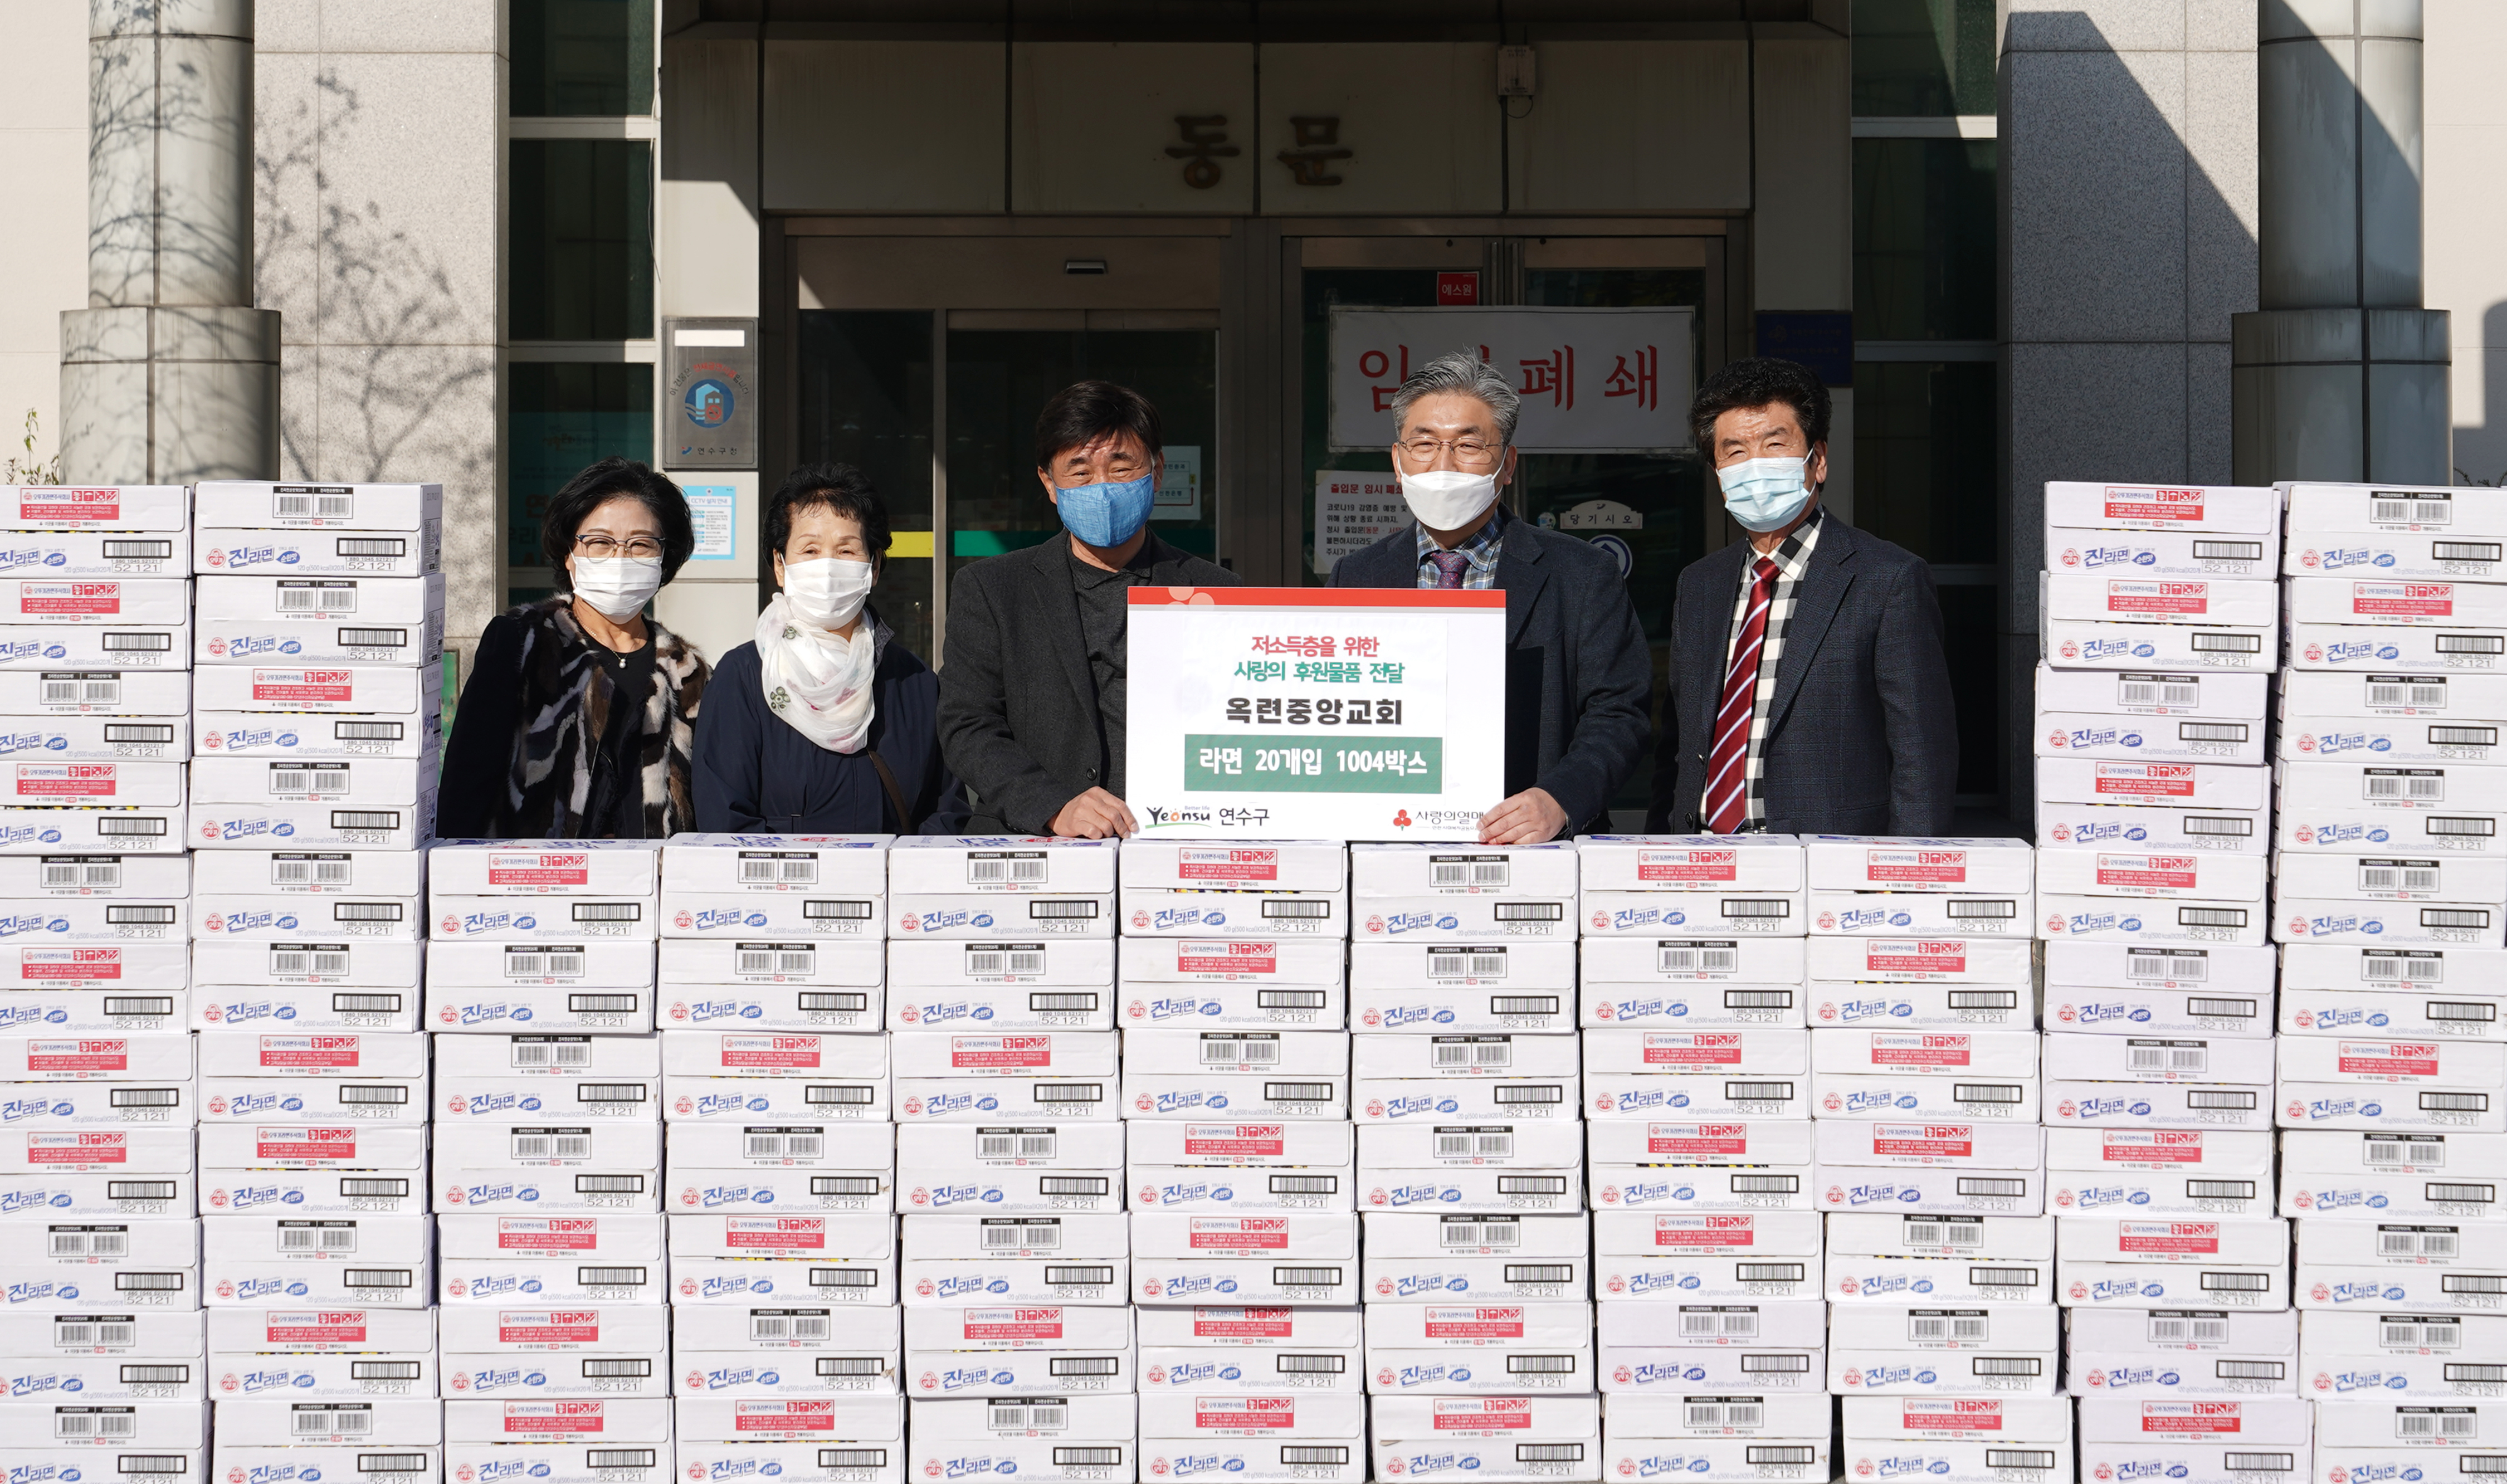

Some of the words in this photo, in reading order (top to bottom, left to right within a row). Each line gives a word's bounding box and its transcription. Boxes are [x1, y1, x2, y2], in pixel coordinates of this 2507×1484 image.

[1441, 284, 1472, 296] 에스원
[698, 447, 737, 456] 연수구청
[1331, 484, 1359, 494] 출입문
[1364, 484, 1383, 494] 임시
[228, 546, 274, 568] 진라면
[280, 552, 297, 563] 순한맛
[2321, 548, 2368, 570] 진라면
[1252, 636, 1337, 657] 저소득층을
[1343, 636, 1379, 657] 위한
[2082, 638, 2129, 661] 진라면
[1234, 661, 1285, 682] 사랑의
[1293, 662, 1361, 682] 후원물품
[1369, 662, 1405, 684] 전달
[1226, 697, 1402, 725] 옥련중앙교회
[1199, 748, 1243, 774] 라면
[1255, 749, 1321, 776] 20개입
[1336, 750, 1427, 775] 1004박스
[1147, 807, 1210, 826] Yeonsu
[1220, 808, 1270, 826] 연수구
[222, 818, 269, 841] 진라면
[2316, 823, 2363, 846] 진라면
[464, 911, 510, 934] 진라면
[921, 910, 968, 932] 진라면
[1154, 907, 1200, 930] 진라면
[1206, 914, 1223, 924] 순한맛
[1839, 908, 1885, 930] 진라면
[1383, 1005, 1429, 1028] 진라면
[2079, 1003, 2125, 1025] 진라면
[697, 1093, 743, 1115] 진라면
[1618, 1089, 1664, 1111] 진라면
[2309, 1098, 2355, 1120] 진라면
[232, 1186, 278, 1208] 진라면
[931, 1184, 978, 1207] 진라면
[1161, 1183, 1207, 1205] 진라면
[1213, 1189, 1231, 1199] 순한맛
[1848, 1184, 1895, 1206] 진라면
[470, 1275, 516, 1297] 진라면
[1397, 1273, 1443, 1296] 진라면
[11, 1374, 57, 1396] 진라면
[708, 1367, 754, 1389] 진라면
[1865, 1365, 1911, 1388] 진라면
[945, 1456, 992, 1478] 진라면
[1173, 1454, 1219, 1476] 진라면
[1638, 1454, 1684, 1477] 진라면
